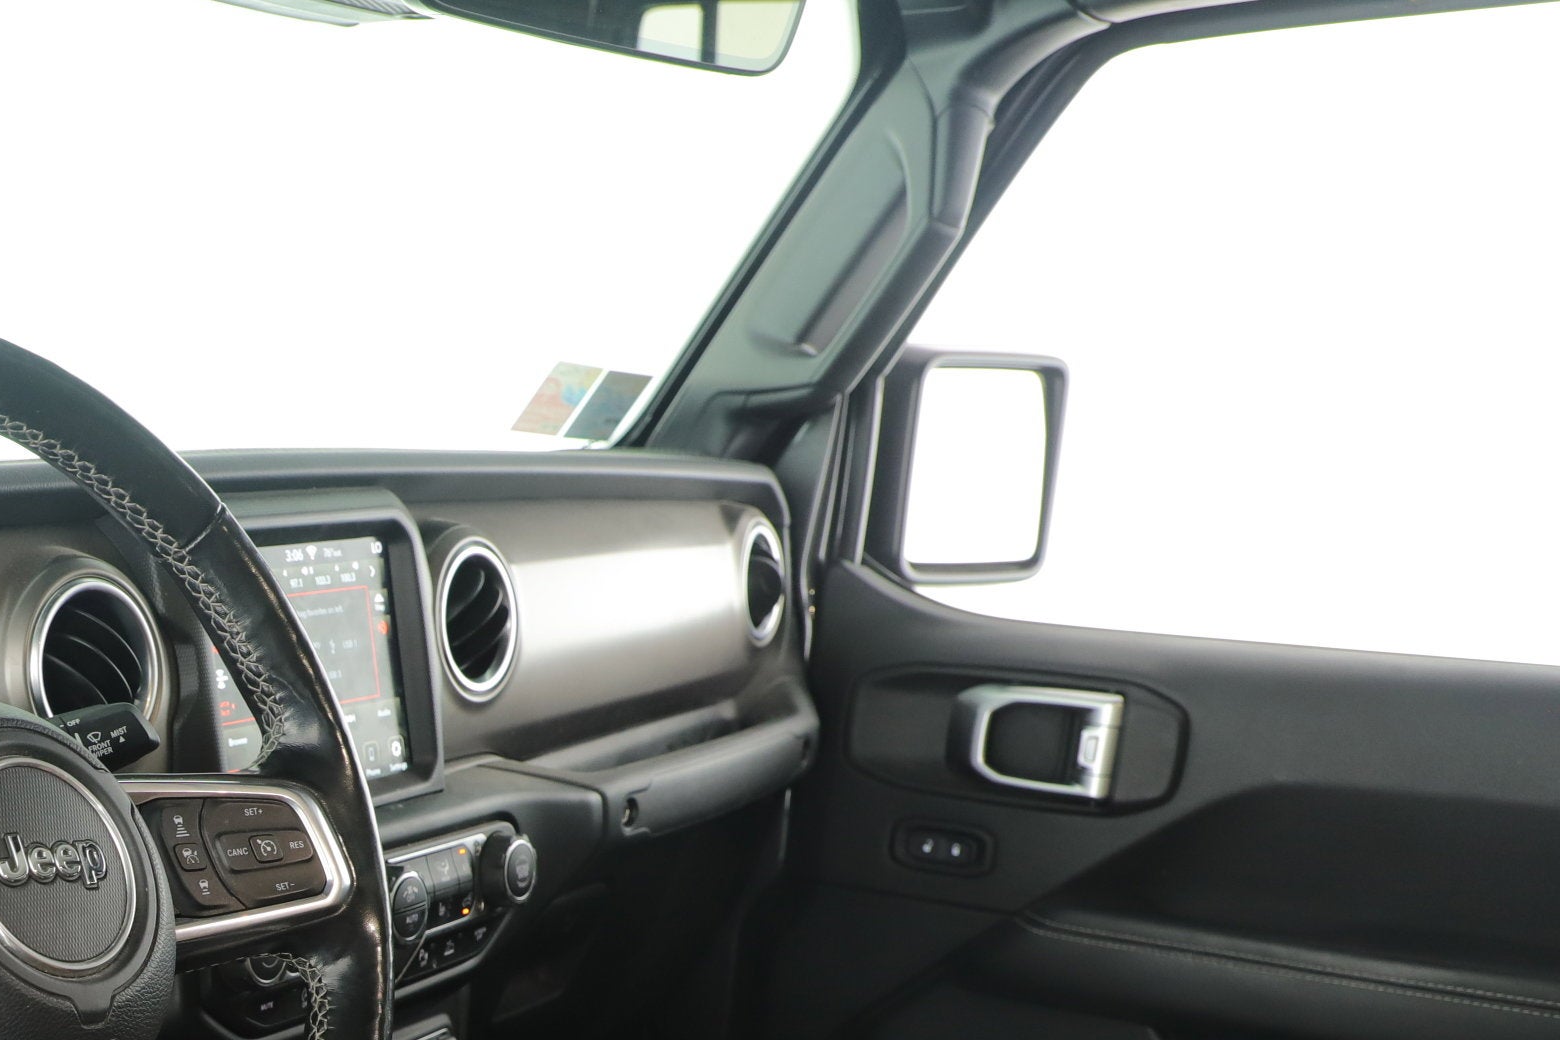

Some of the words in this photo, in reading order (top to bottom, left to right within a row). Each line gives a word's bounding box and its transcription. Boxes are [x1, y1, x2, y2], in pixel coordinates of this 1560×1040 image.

[67, 718, 80, 727] OFF
[110, 725, 128, 738] MIST
[88, 739, 111, 752] FRONT
[290, 841, 305, 849] RES
[227, 847, 249, 857] CANC
